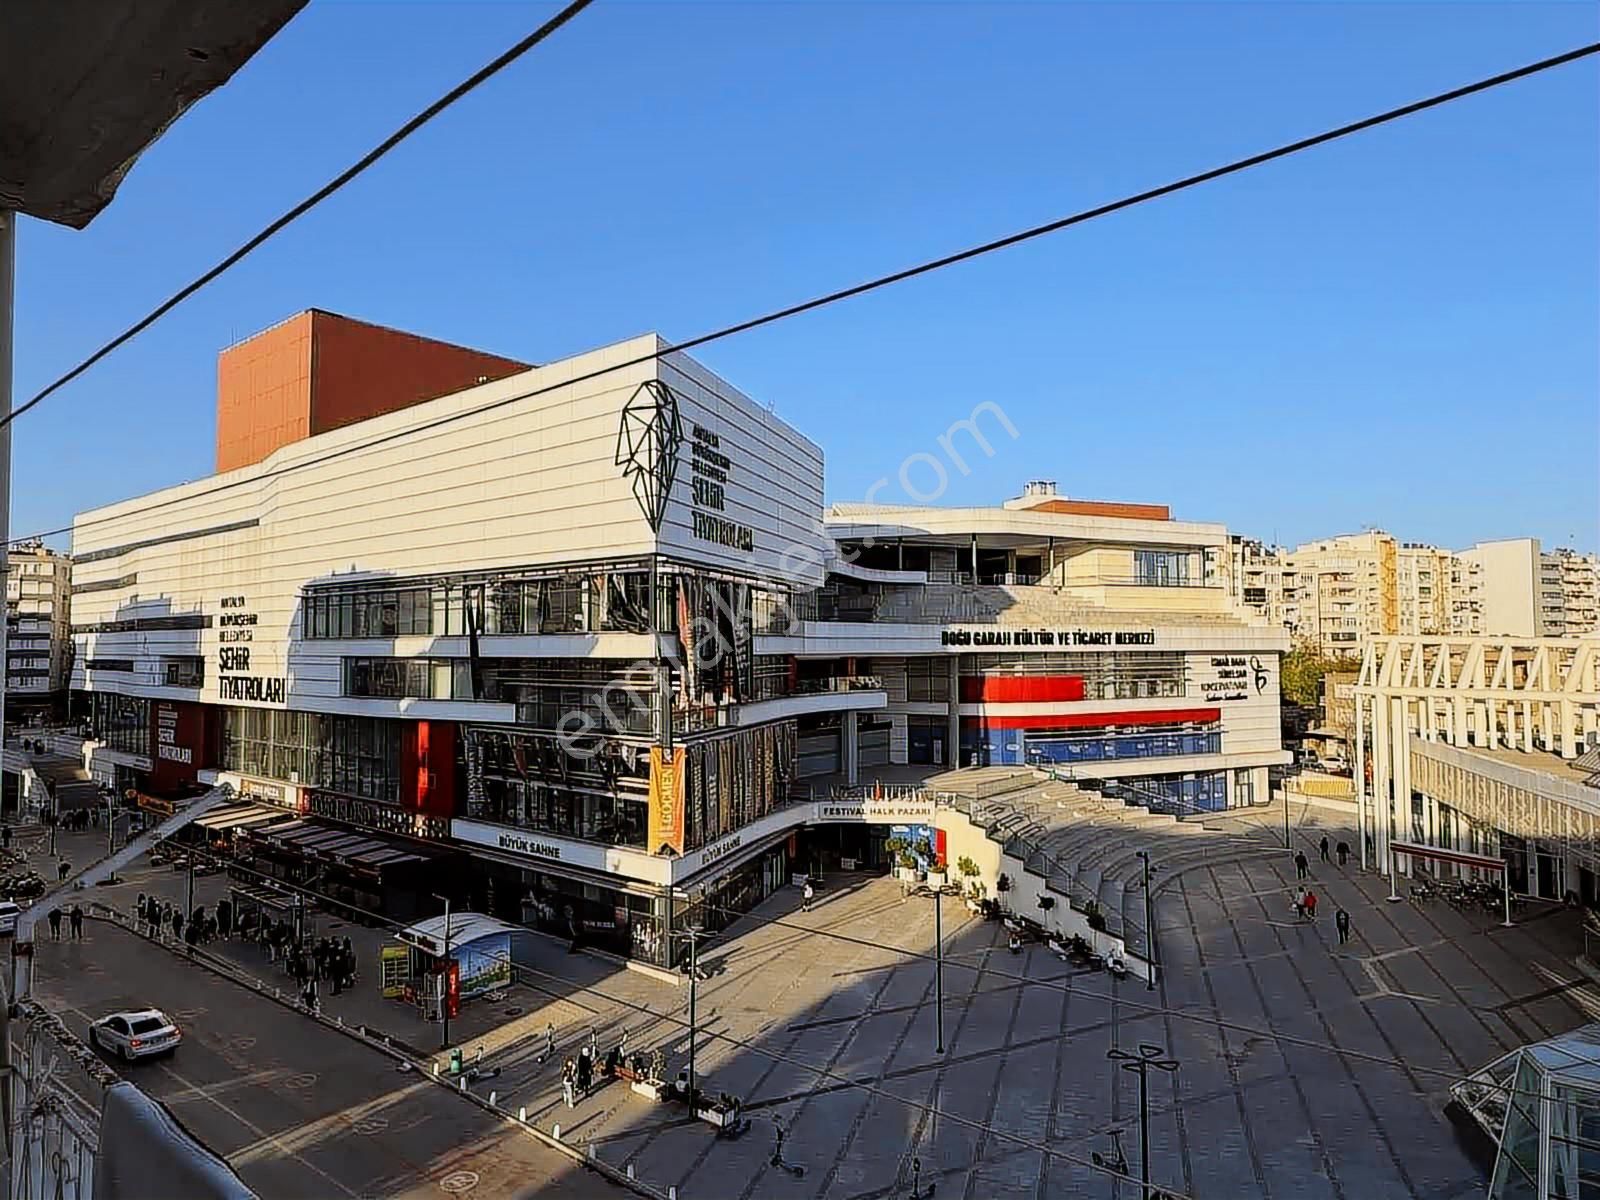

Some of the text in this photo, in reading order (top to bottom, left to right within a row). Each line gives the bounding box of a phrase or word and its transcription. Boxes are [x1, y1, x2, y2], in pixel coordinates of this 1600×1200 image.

[941, 628, 971, 646] DOĞU
[1013, 628, 1055, 646] KÜLTÜR
[1057, 631, 1071, 646] VE
[1072, 628, 1112, 646] TİCARET
[1114, 628, 1155, 646] MERKEZİ
[218, 646, 250, 673] ŞEHİR
[218, 675, 285, 704] TİYATROLARI
[869, 807, 895, 816] HALK
[897, 807, 932, 816] PAZARI
[499, 834, 560, 859] BÜYÜK SAHNE
